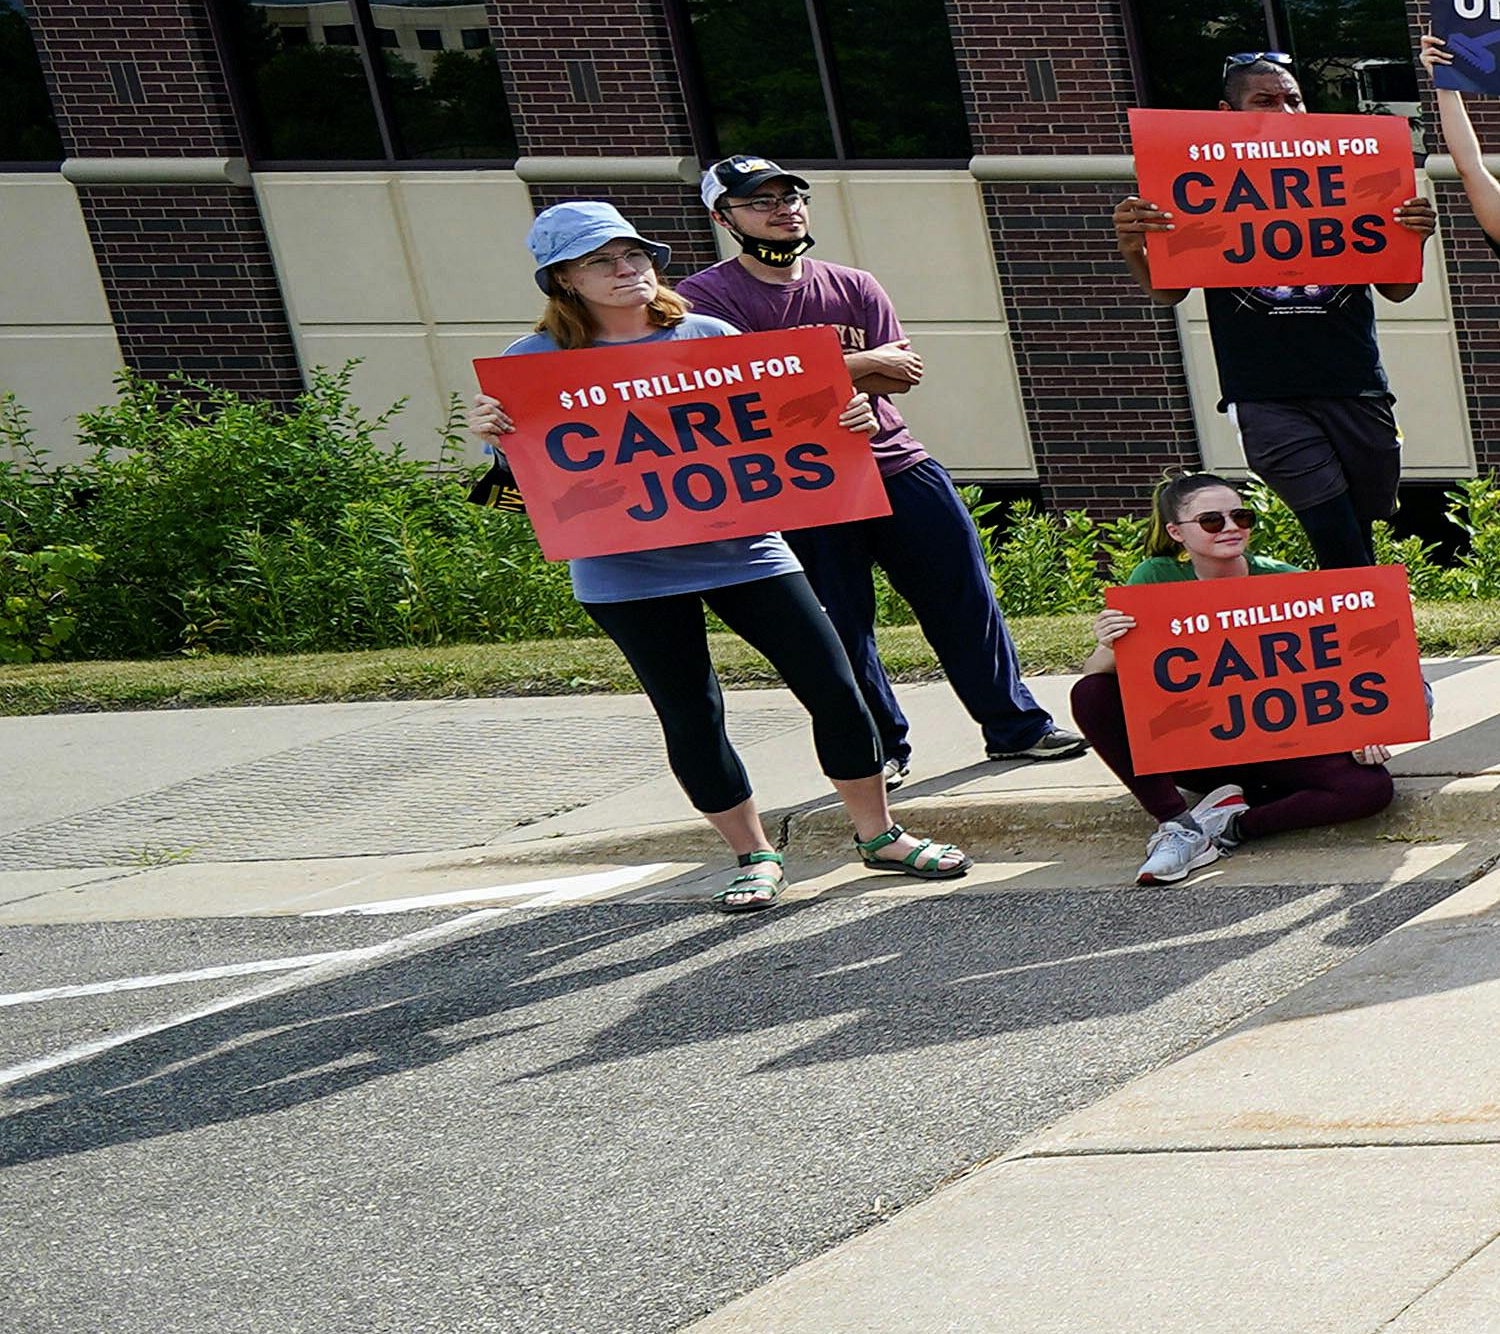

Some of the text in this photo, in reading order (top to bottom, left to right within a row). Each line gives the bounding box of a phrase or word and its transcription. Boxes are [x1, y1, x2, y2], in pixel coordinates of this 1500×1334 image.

[1190, 138, 1378, 160] $10 TRILLION FOR
[1173, 166, 1346, 214] CARE
[1223, 215, 1387, 263] JOBS
[560, 356, 803, 409] $10 TRILLION FOR
[545, 392, 772, 471] CARE
[626, 443, 835, 521] JOBS
[1171, 591, 1375, 635] $10 TRILLION FOR
[1154, 622, 1341, 693] CARE
[1211, 672, 1389, 740] JOBS
